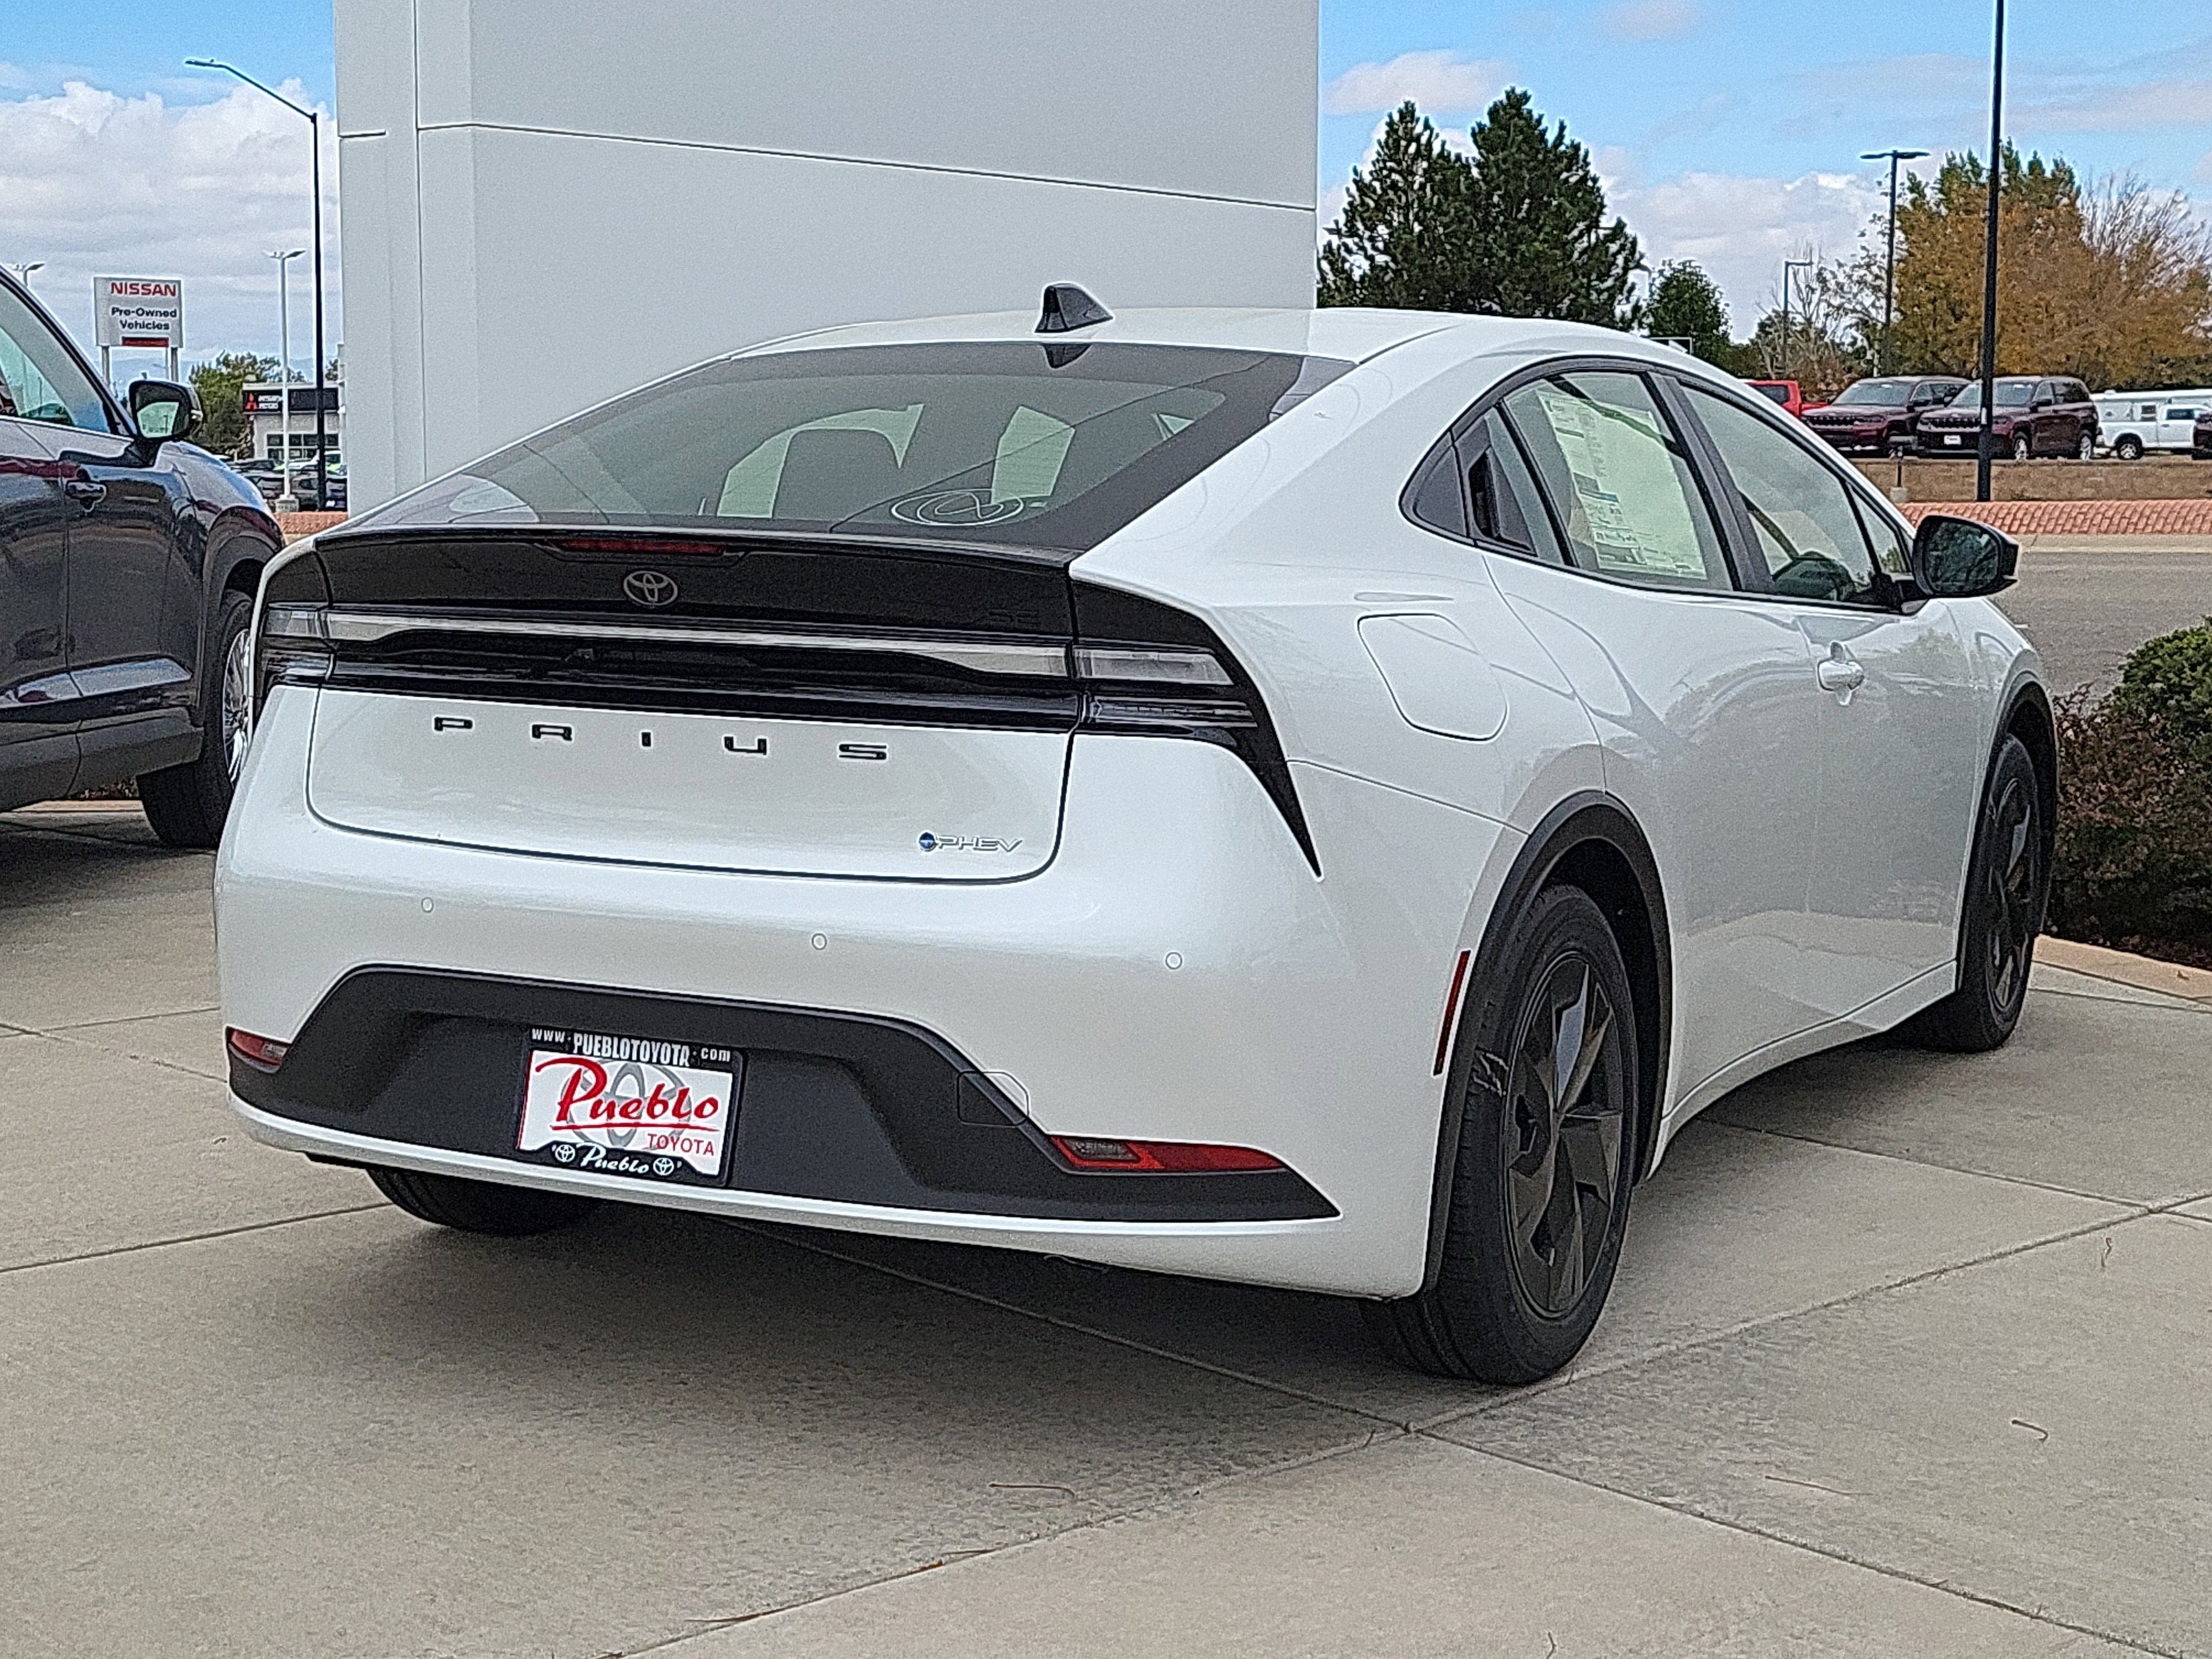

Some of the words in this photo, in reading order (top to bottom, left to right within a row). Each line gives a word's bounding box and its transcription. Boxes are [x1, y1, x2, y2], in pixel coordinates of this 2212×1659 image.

[111, 282, 176, 296] NISSAN
[111, 307, 177, 317] Pre-Owned
[119, 320, 169, 330] Vehicles
[434, 717, 886, 759] PRIUS
[937, 835, 1022, 852] PHEV
[535, 1057, 718, 1121] Pueblo
[647, 1133, 714, 1156] TOYOTA
[576, 1142, 649, 1174] Pueblo
